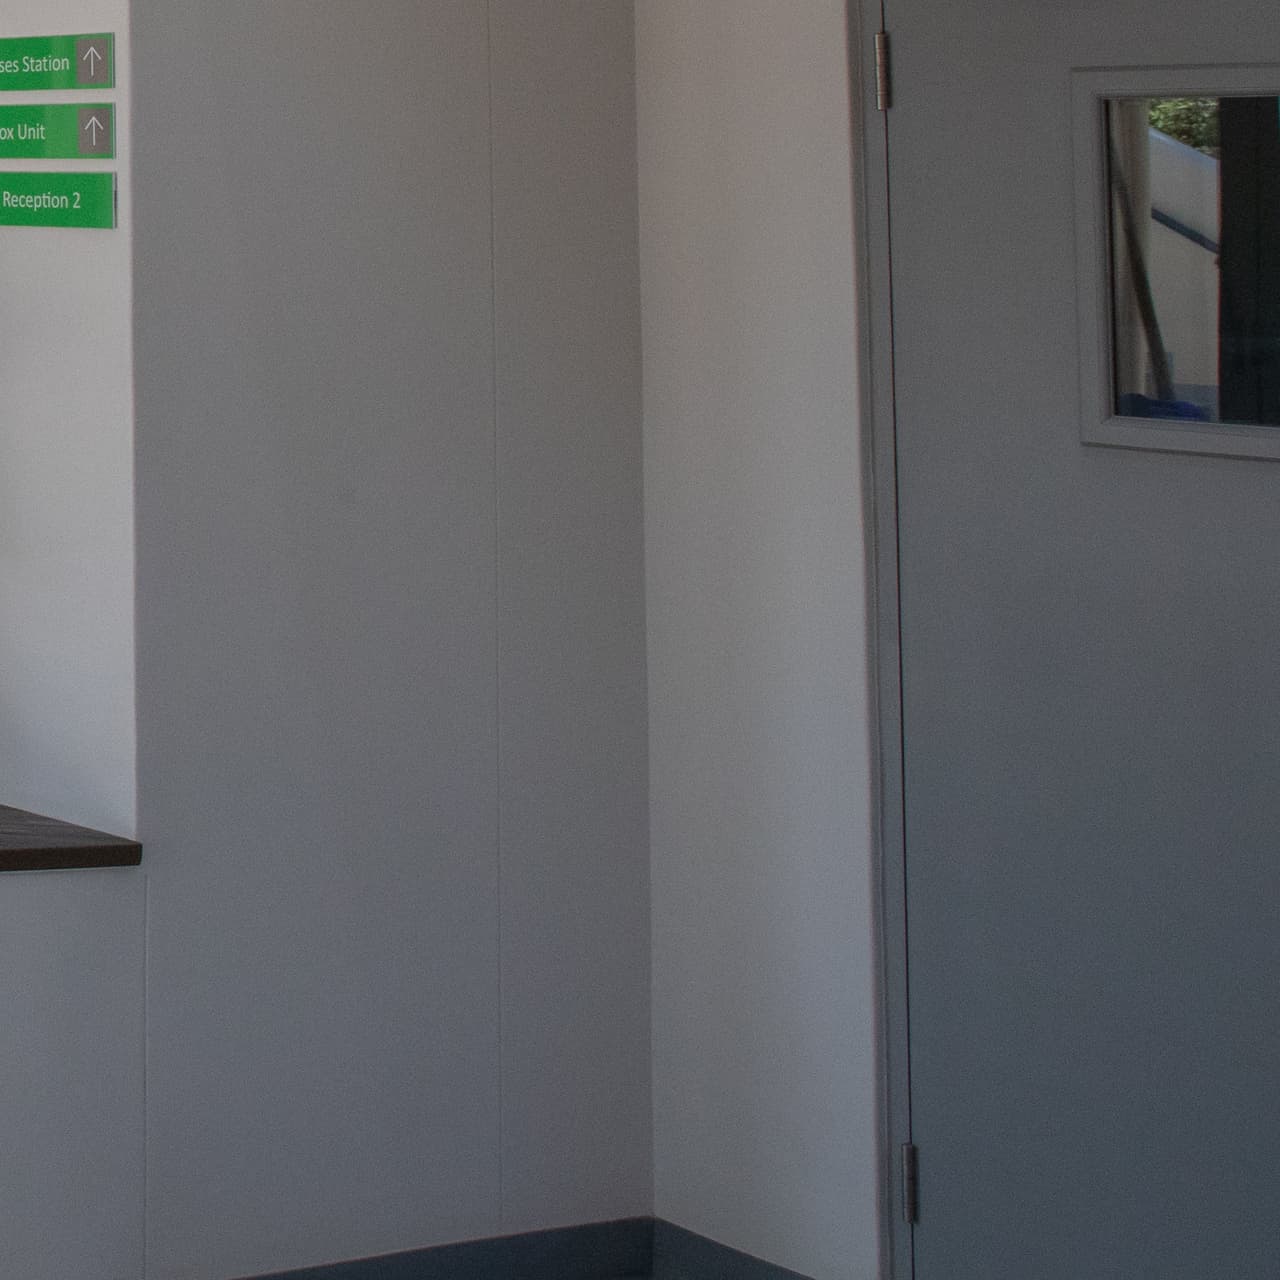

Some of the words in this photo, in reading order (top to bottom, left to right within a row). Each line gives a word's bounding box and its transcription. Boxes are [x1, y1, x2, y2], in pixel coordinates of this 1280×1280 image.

[22, 55, 70, 72] Station
[18, 122, 46, 140] Unit
[2, 191, 69, 212] Reception
[72, 192, 81, 209] 2
